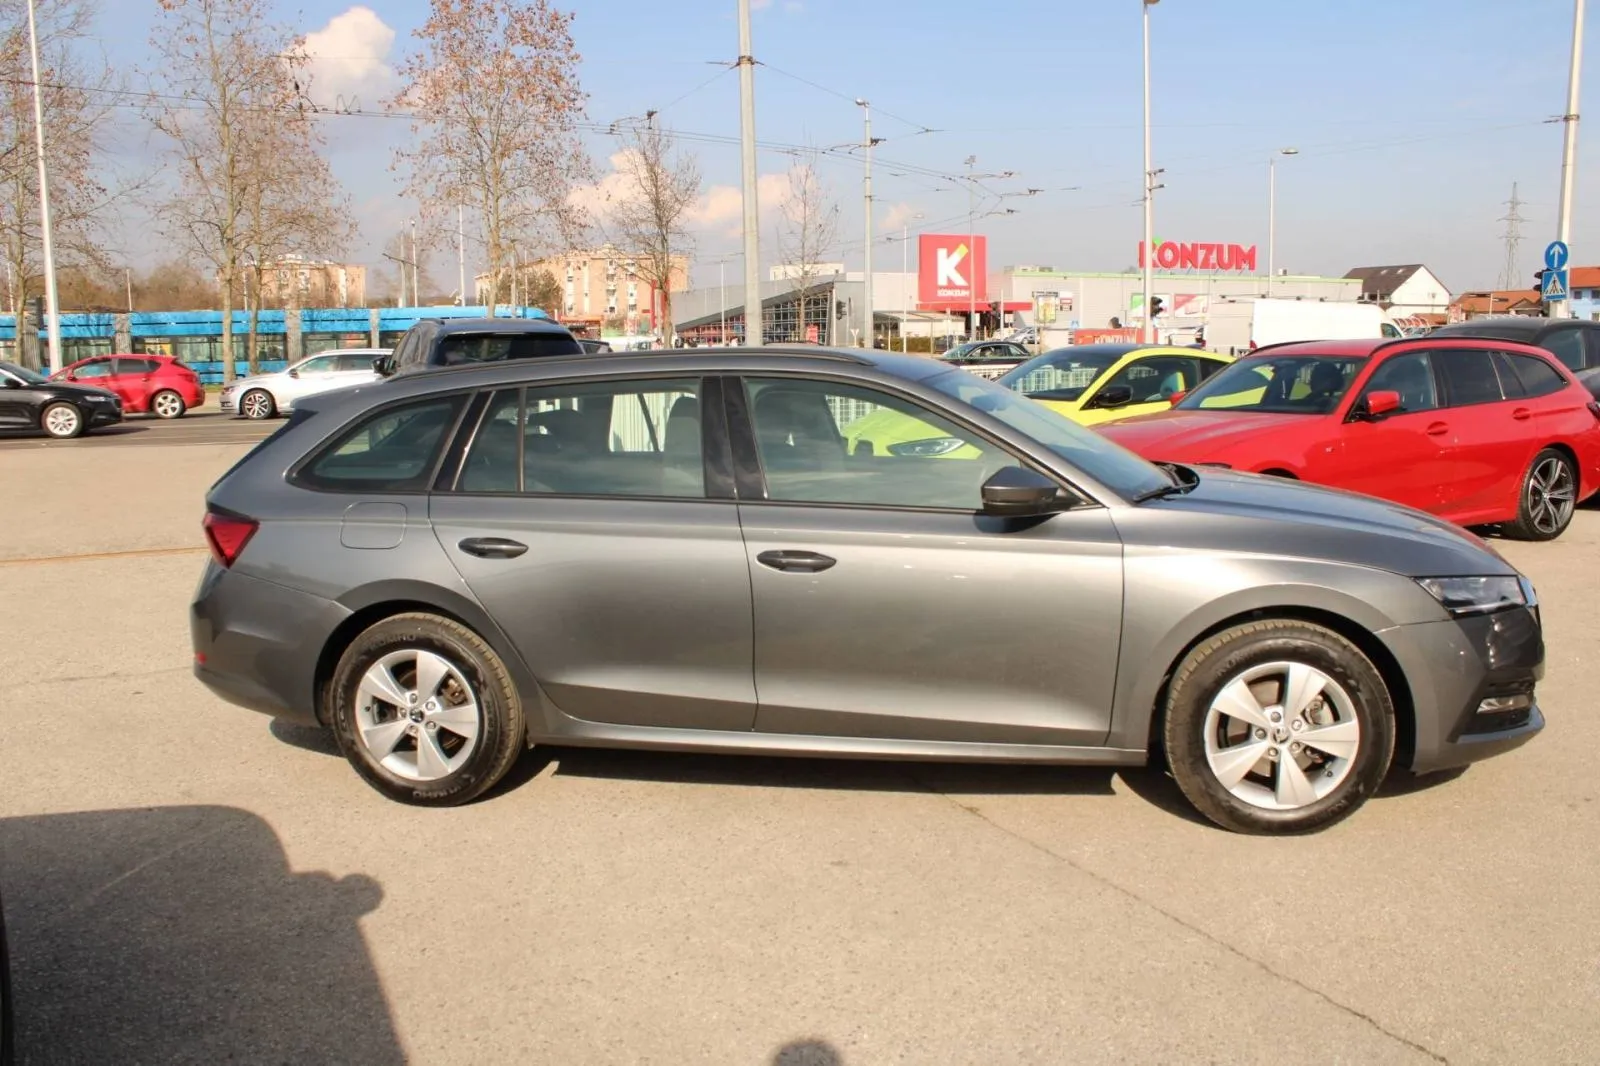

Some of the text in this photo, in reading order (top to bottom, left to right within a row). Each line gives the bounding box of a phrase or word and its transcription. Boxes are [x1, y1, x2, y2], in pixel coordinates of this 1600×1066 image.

[937, 243, 969, 286] K
[1138, 238, 1256, 270] KONZUM
[937, 289, 970, 297] KONZUM
